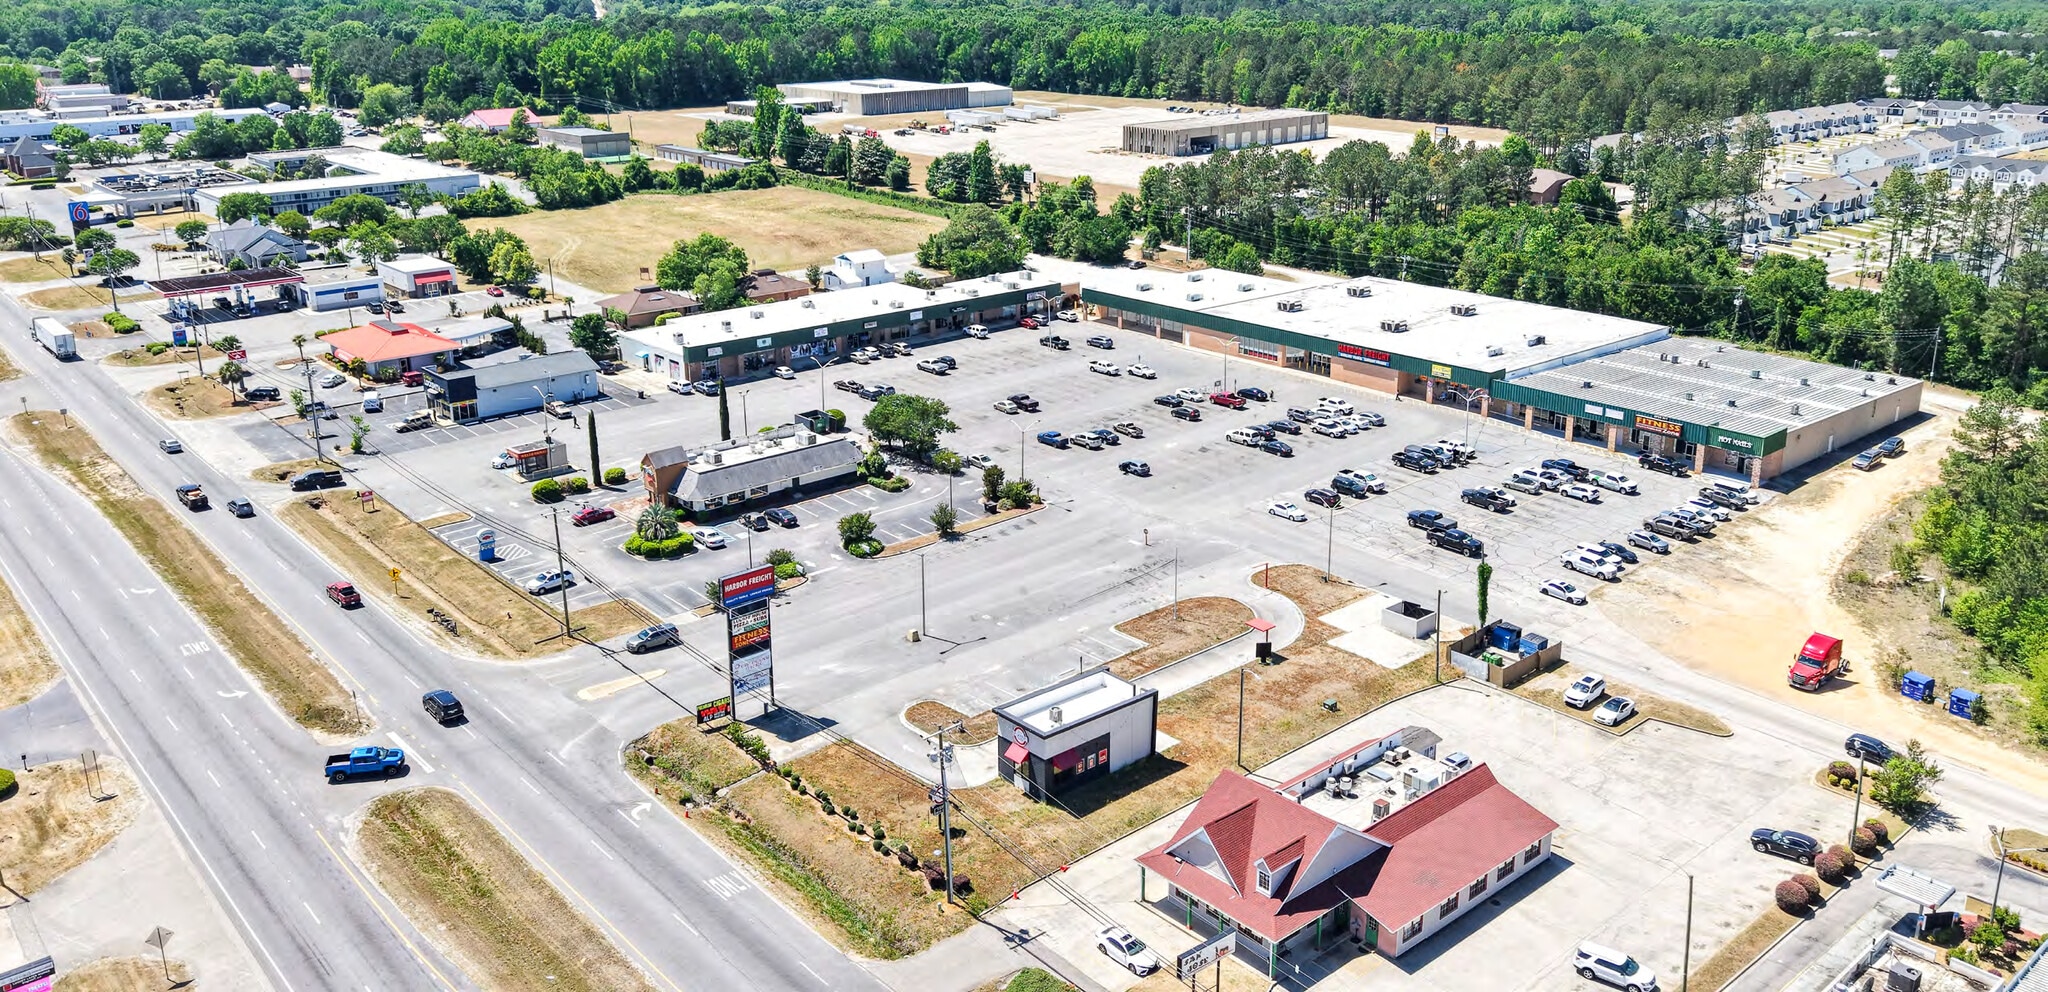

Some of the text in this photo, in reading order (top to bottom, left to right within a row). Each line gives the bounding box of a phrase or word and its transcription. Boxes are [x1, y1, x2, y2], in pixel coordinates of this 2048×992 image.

[73, 203, 88, 221] 6
[1337, 343, 1363, 356] HARBOR
[1364, 348, 1391, 361] FREIGHT
[1636, 416, 1682, 431] FITNESS
[724, 572, 773, 593] HARBOR FREIGHT
[733, 619, 749, 629] PIZZA
[753, 613, 768, 623] SUBS
[733, 626, 770, 644] FITNESS
[180, 640, 210, 657] ONLY
[708, 869, 752, 899] ONLY
